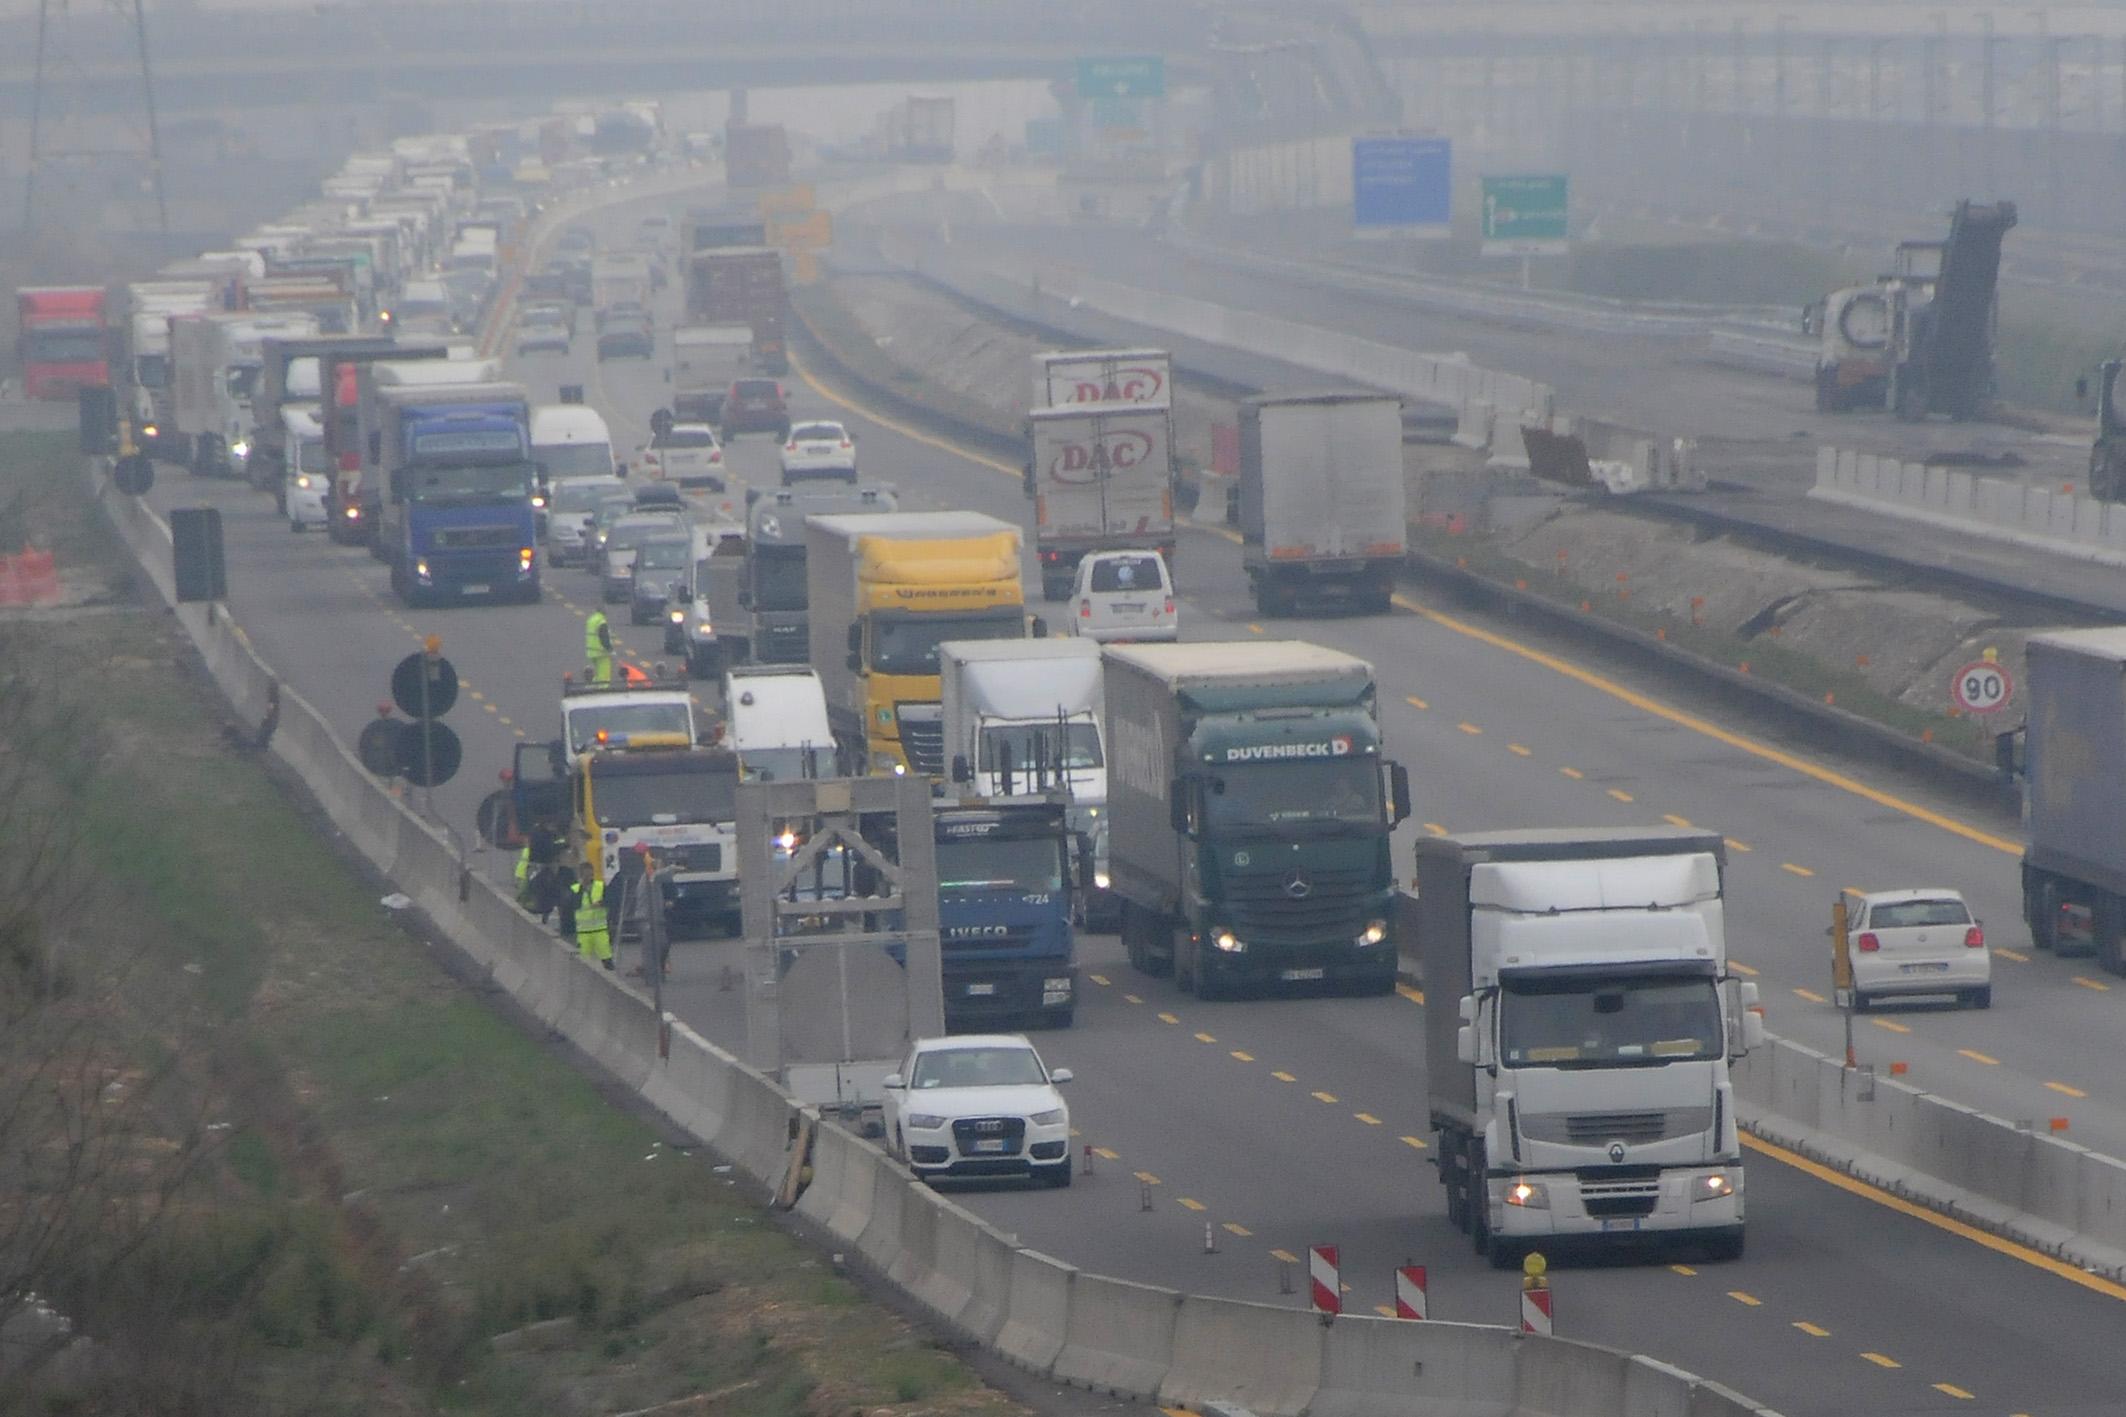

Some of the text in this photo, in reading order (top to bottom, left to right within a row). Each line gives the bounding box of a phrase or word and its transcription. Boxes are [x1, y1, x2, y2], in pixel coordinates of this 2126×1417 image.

[1062, 443, 1136, 471] DAC
[1966, 675, 2001, 701] 90
[1226, 743, 1329, 760] DUVENBECK
[949, 926, 1009, 937] IVECO
